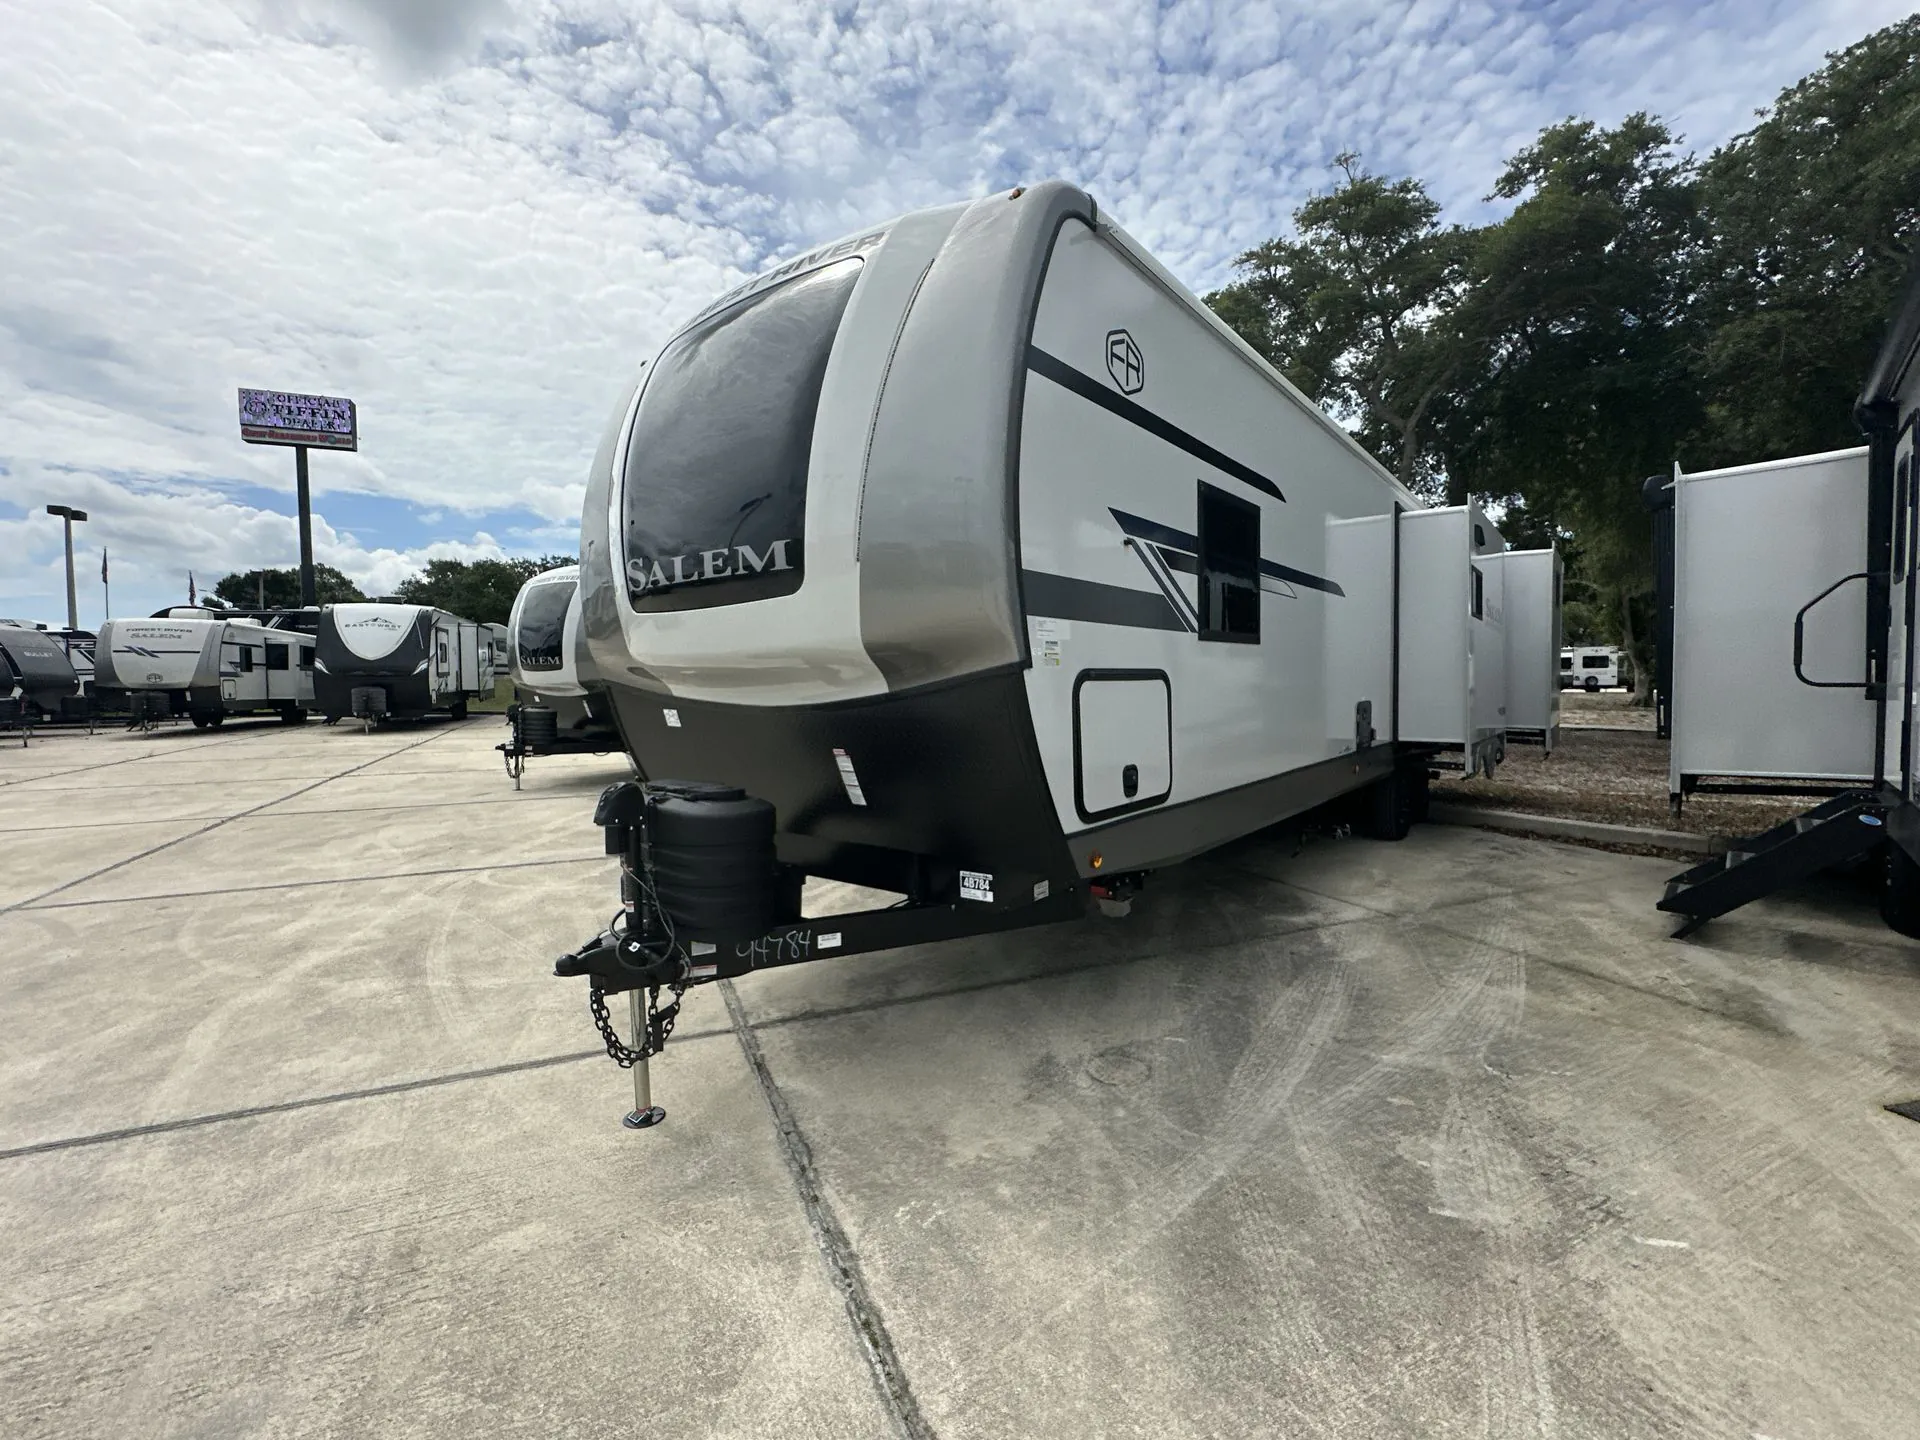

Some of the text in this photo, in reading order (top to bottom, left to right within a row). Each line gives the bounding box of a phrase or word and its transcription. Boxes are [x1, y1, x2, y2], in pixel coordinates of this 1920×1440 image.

[770, 231, 886, 281] RIVER
[277, 394, 340, 408] OFFICIAL
[272, 403, 346, 421] TIFFIN
[282, 416, 337, 431] DEALER
[626, 539, 794, 593] SALEM
[520, 655, 562, 666] SALEM
[736, 929, 812, 968] 44784
